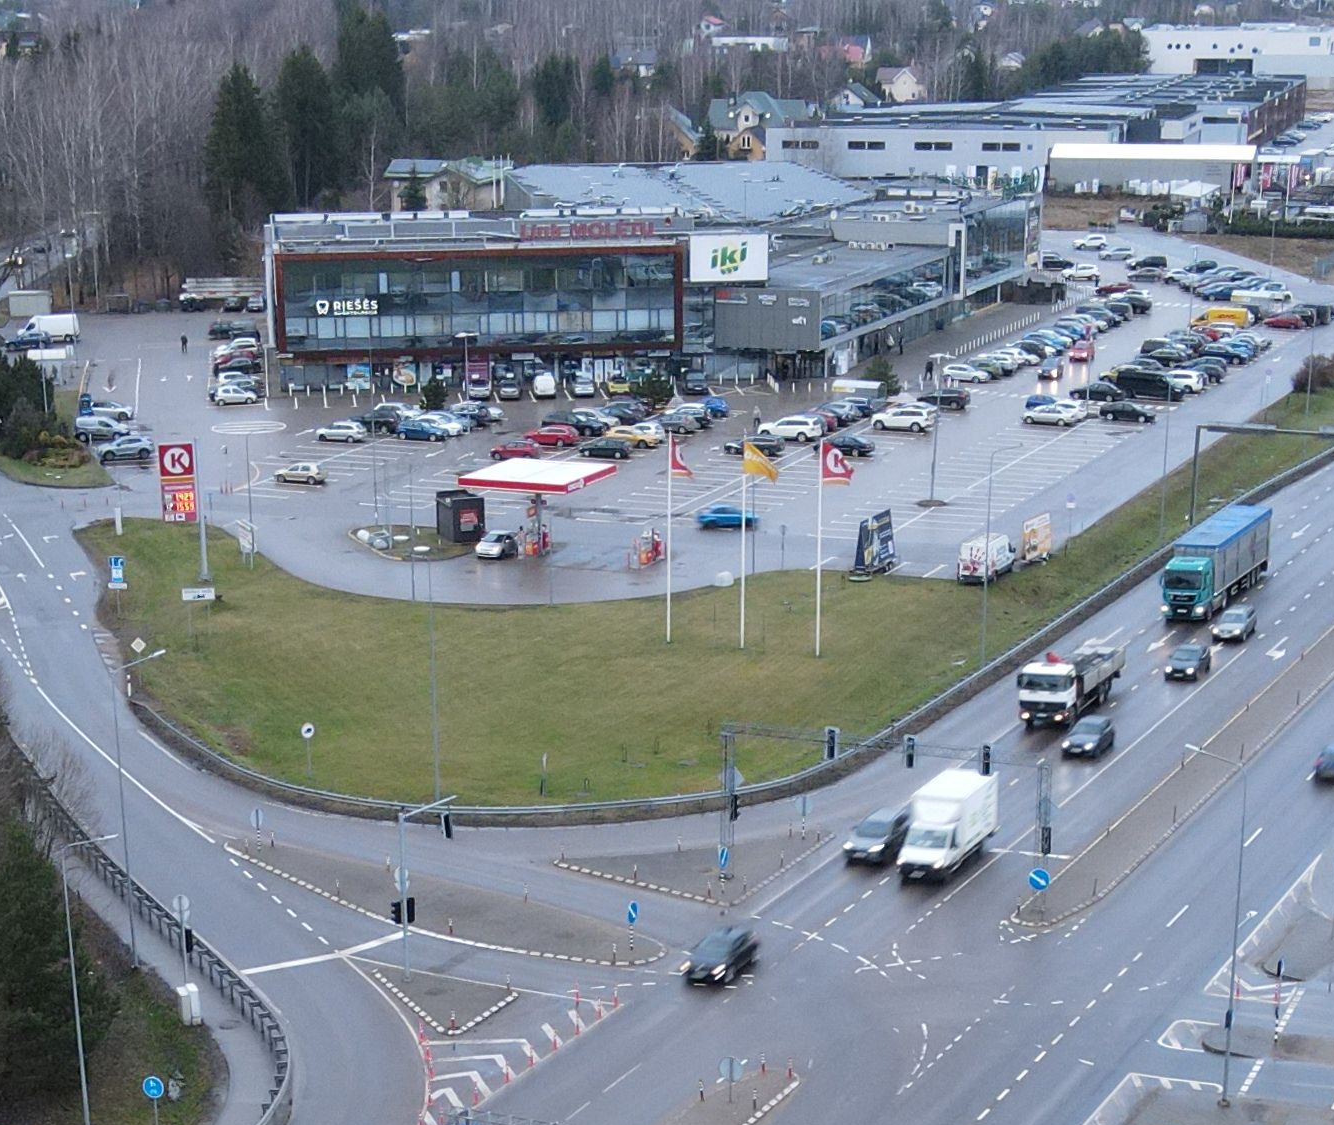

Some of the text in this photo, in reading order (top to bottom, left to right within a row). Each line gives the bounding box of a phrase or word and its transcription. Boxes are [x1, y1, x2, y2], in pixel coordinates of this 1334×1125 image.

[519, 223, 562, 241] Link
[710, 240, 748, 269] iki
[170, 452, 188, 470] K
